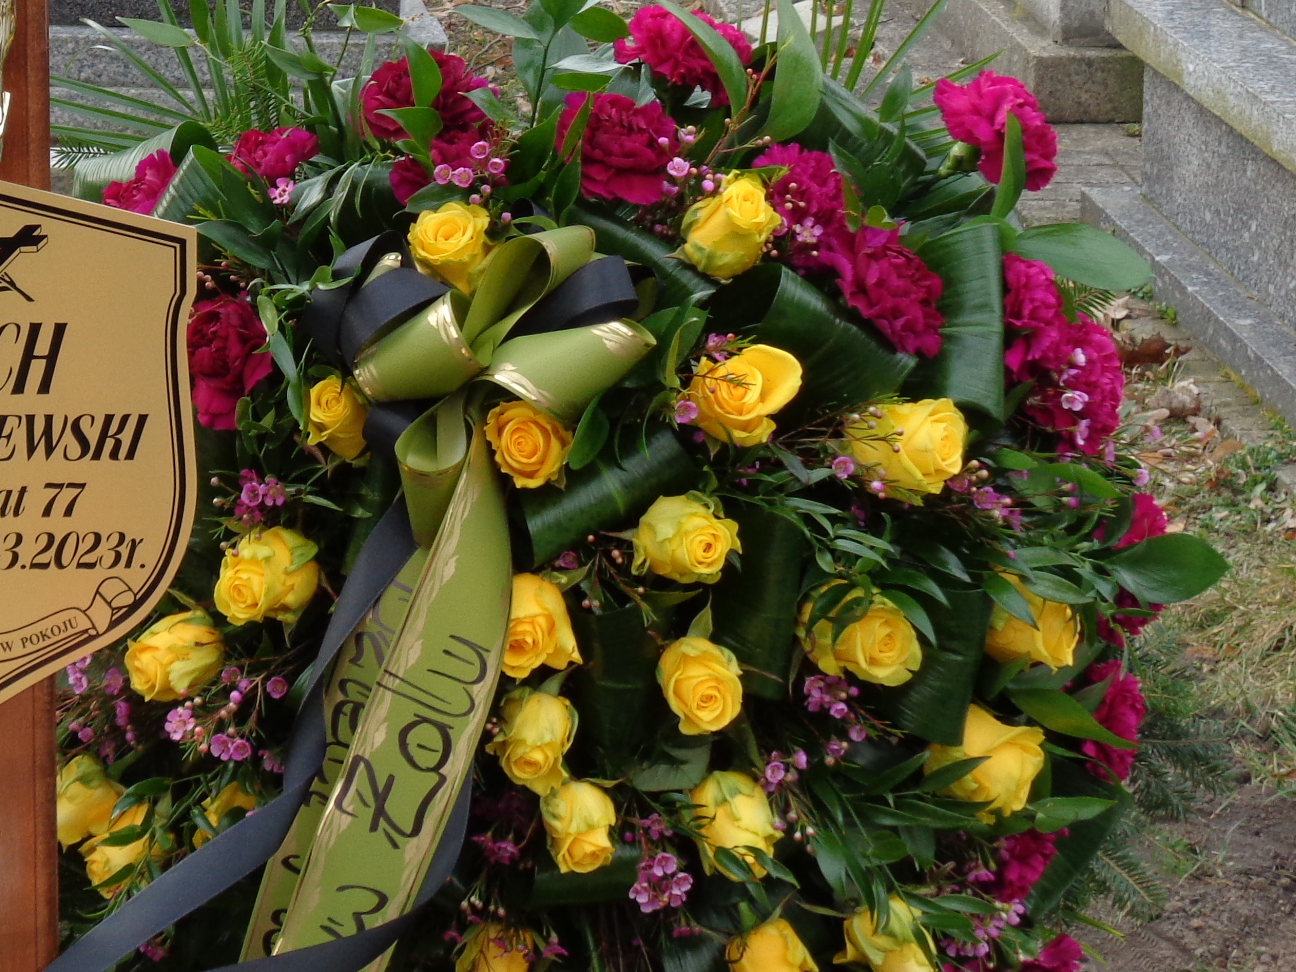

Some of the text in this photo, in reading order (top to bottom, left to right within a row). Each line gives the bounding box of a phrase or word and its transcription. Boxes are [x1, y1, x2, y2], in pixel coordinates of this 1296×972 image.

[41, 481, 88, 518] 77
[0, 641, 15, 654] W
[20, 616, 80, 650] POKOJU
